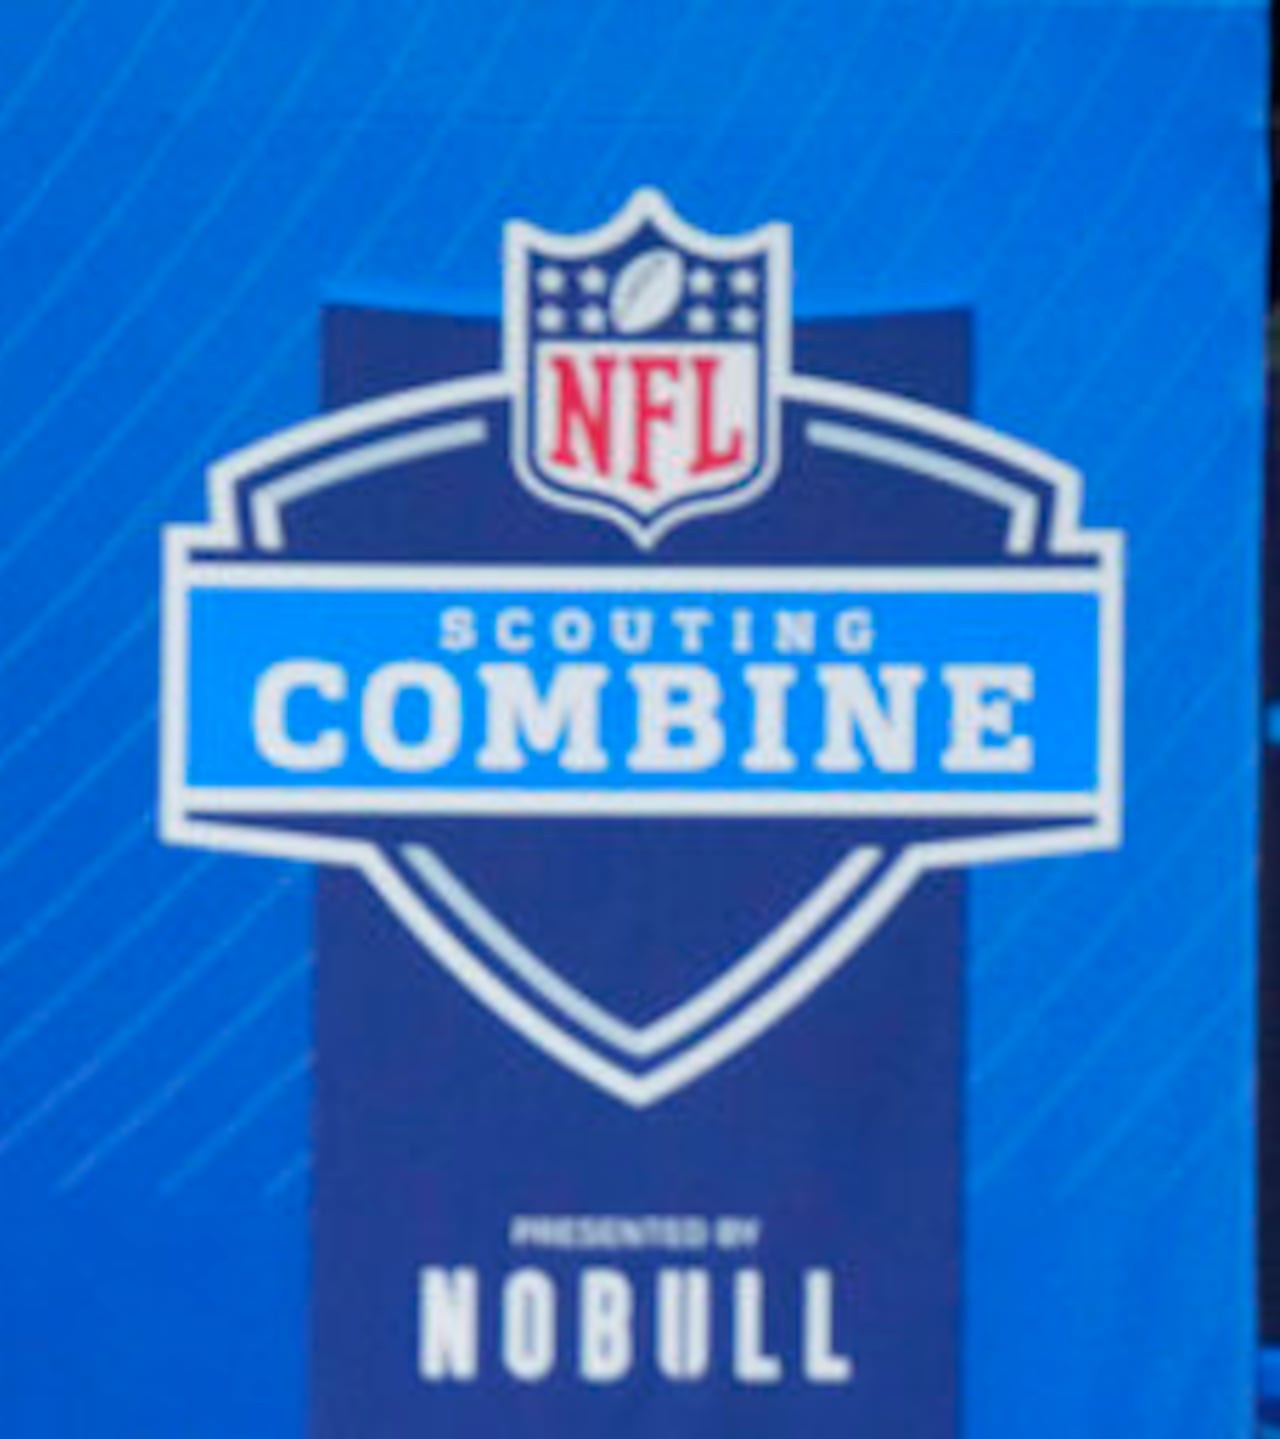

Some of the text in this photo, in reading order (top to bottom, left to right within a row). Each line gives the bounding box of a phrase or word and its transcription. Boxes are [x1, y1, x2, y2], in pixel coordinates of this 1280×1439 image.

[548, 354, 742, 490] NFL
[440, 608, 876, 654] SCOUTING
[250, 659, 1035, 773] COMBINE
[508, 1215, 760, 1249] PRESENTED BY
[419, 1265, 853, 1383] NOBULL
